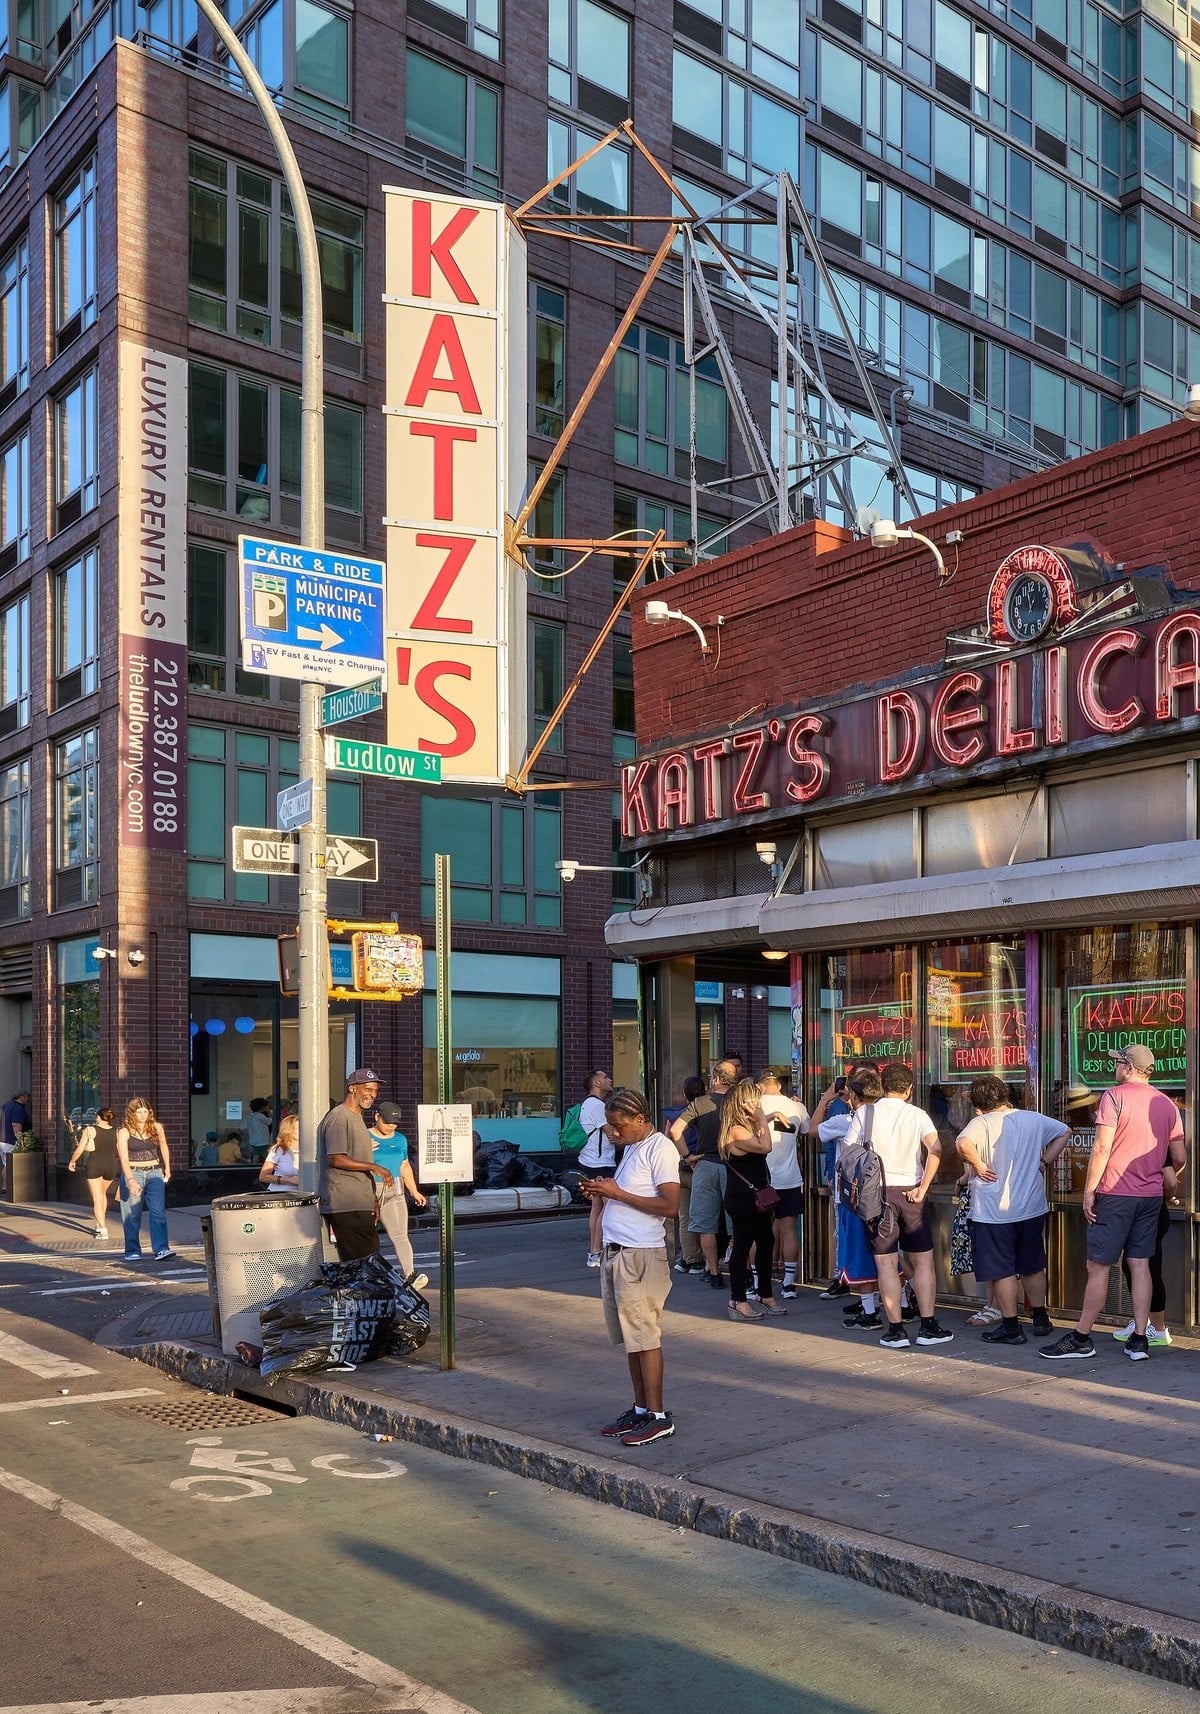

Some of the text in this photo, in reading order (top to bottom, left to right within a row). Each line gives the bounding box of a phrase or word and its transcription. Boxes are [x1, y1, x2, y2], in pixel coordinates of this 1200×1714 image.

[397, 200, 482, 758] KATZ'S
[140, 357, 167, 629] LUXURY RENTALS
[255, 547, 372, 581] PARK & RIDE
[296, 579, 377, 608] MUNICIPAL
[1022, 585, 1027, 596] 11
[1028, 581, 1035, 592] 12
[1037, 582, 1041, 592] 1
[1042, 586, 1047, 597] 2
[296, 598, 362, 622] PARKING
[1015, 595, 1022, 606] 10
[1014, 608, 1019, 618] 9
[1017, 618, 1023, 629] 8
[1023, 624, 1029, 635] 7
[1030, 624, 1035, 635] 6
[1037, 619, 1042, 630] 5
[267, 647, 279, 656] EV
[282, 649, 301, 660] Fast
[313, 654, 336, 665] Level
[339, 659, 345, 667] 2
[347, 660, 386, 674] Charging
[329, 689, 370, 720] Houston
[373, 681, 381, 697] St
[123, 654, 150, 833] theludlownyc.com
[153, 658, 179, 833] 212.387.0188
[335, 742, 437, 776] Ludlow St
[620, 712, 831, 838] KATZ'S
[251, 842, 350, 866] ONE AY
[1087, 993, 1185, 1031] KATZ'S
[1083, 1059, 1105, 1072] BEST
[332, 1300, 396, 1319] LOWER
[331, 1320, 378, 1342] EAST
[326, 1344, 370, 1363] SIDE
